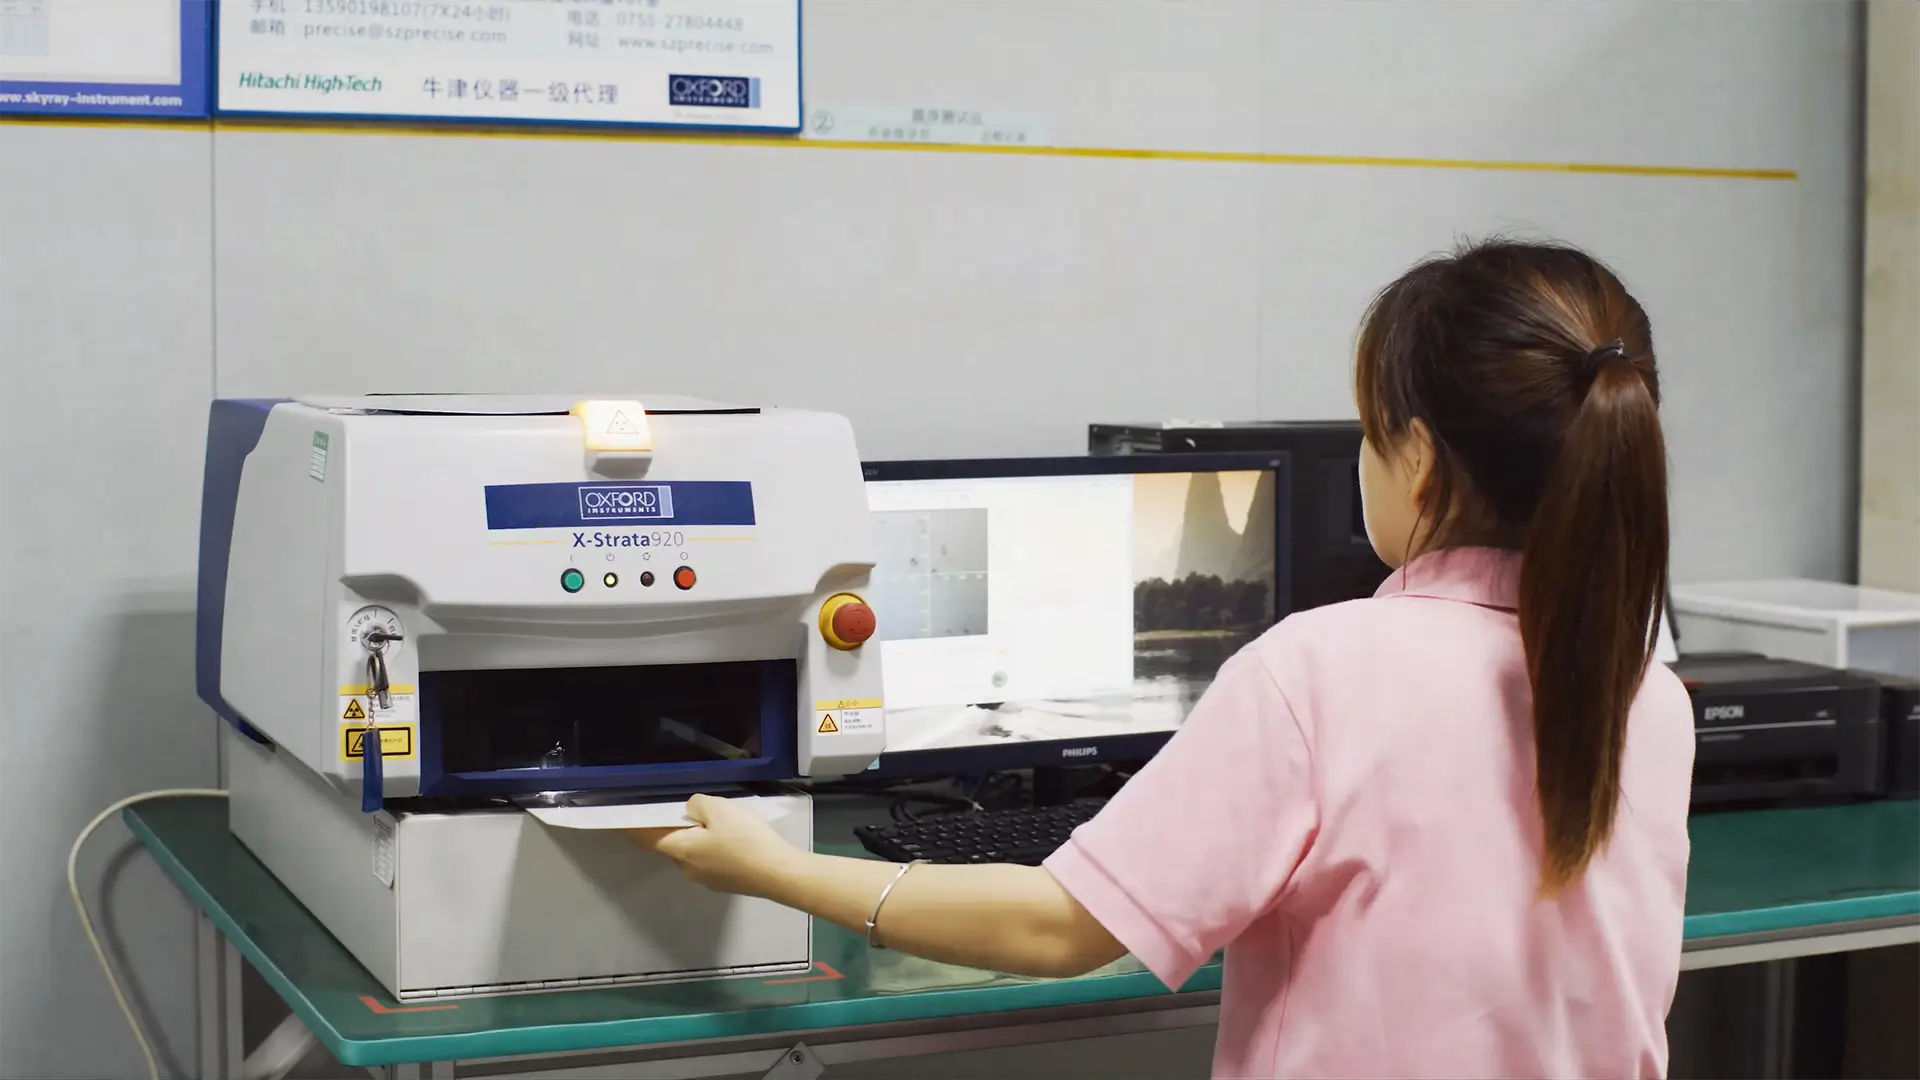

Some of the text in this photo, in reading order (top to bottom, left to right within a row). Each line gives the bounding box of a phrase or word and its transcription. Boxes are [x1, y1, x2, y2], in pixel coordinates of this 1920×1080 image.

[239, 72, 300, 89] Hitachi
[672, 77, 747, 97] OXFORD
[423, 76, 619, 105] 牛津仪器一级代理
[585, 492, 656, 508] OXFORD
[572, 531, 685, 548] X-Strata920
[1704, 705, 1744, 720] EPSON
[1062, 747, 1097, 757] PHILIPS
